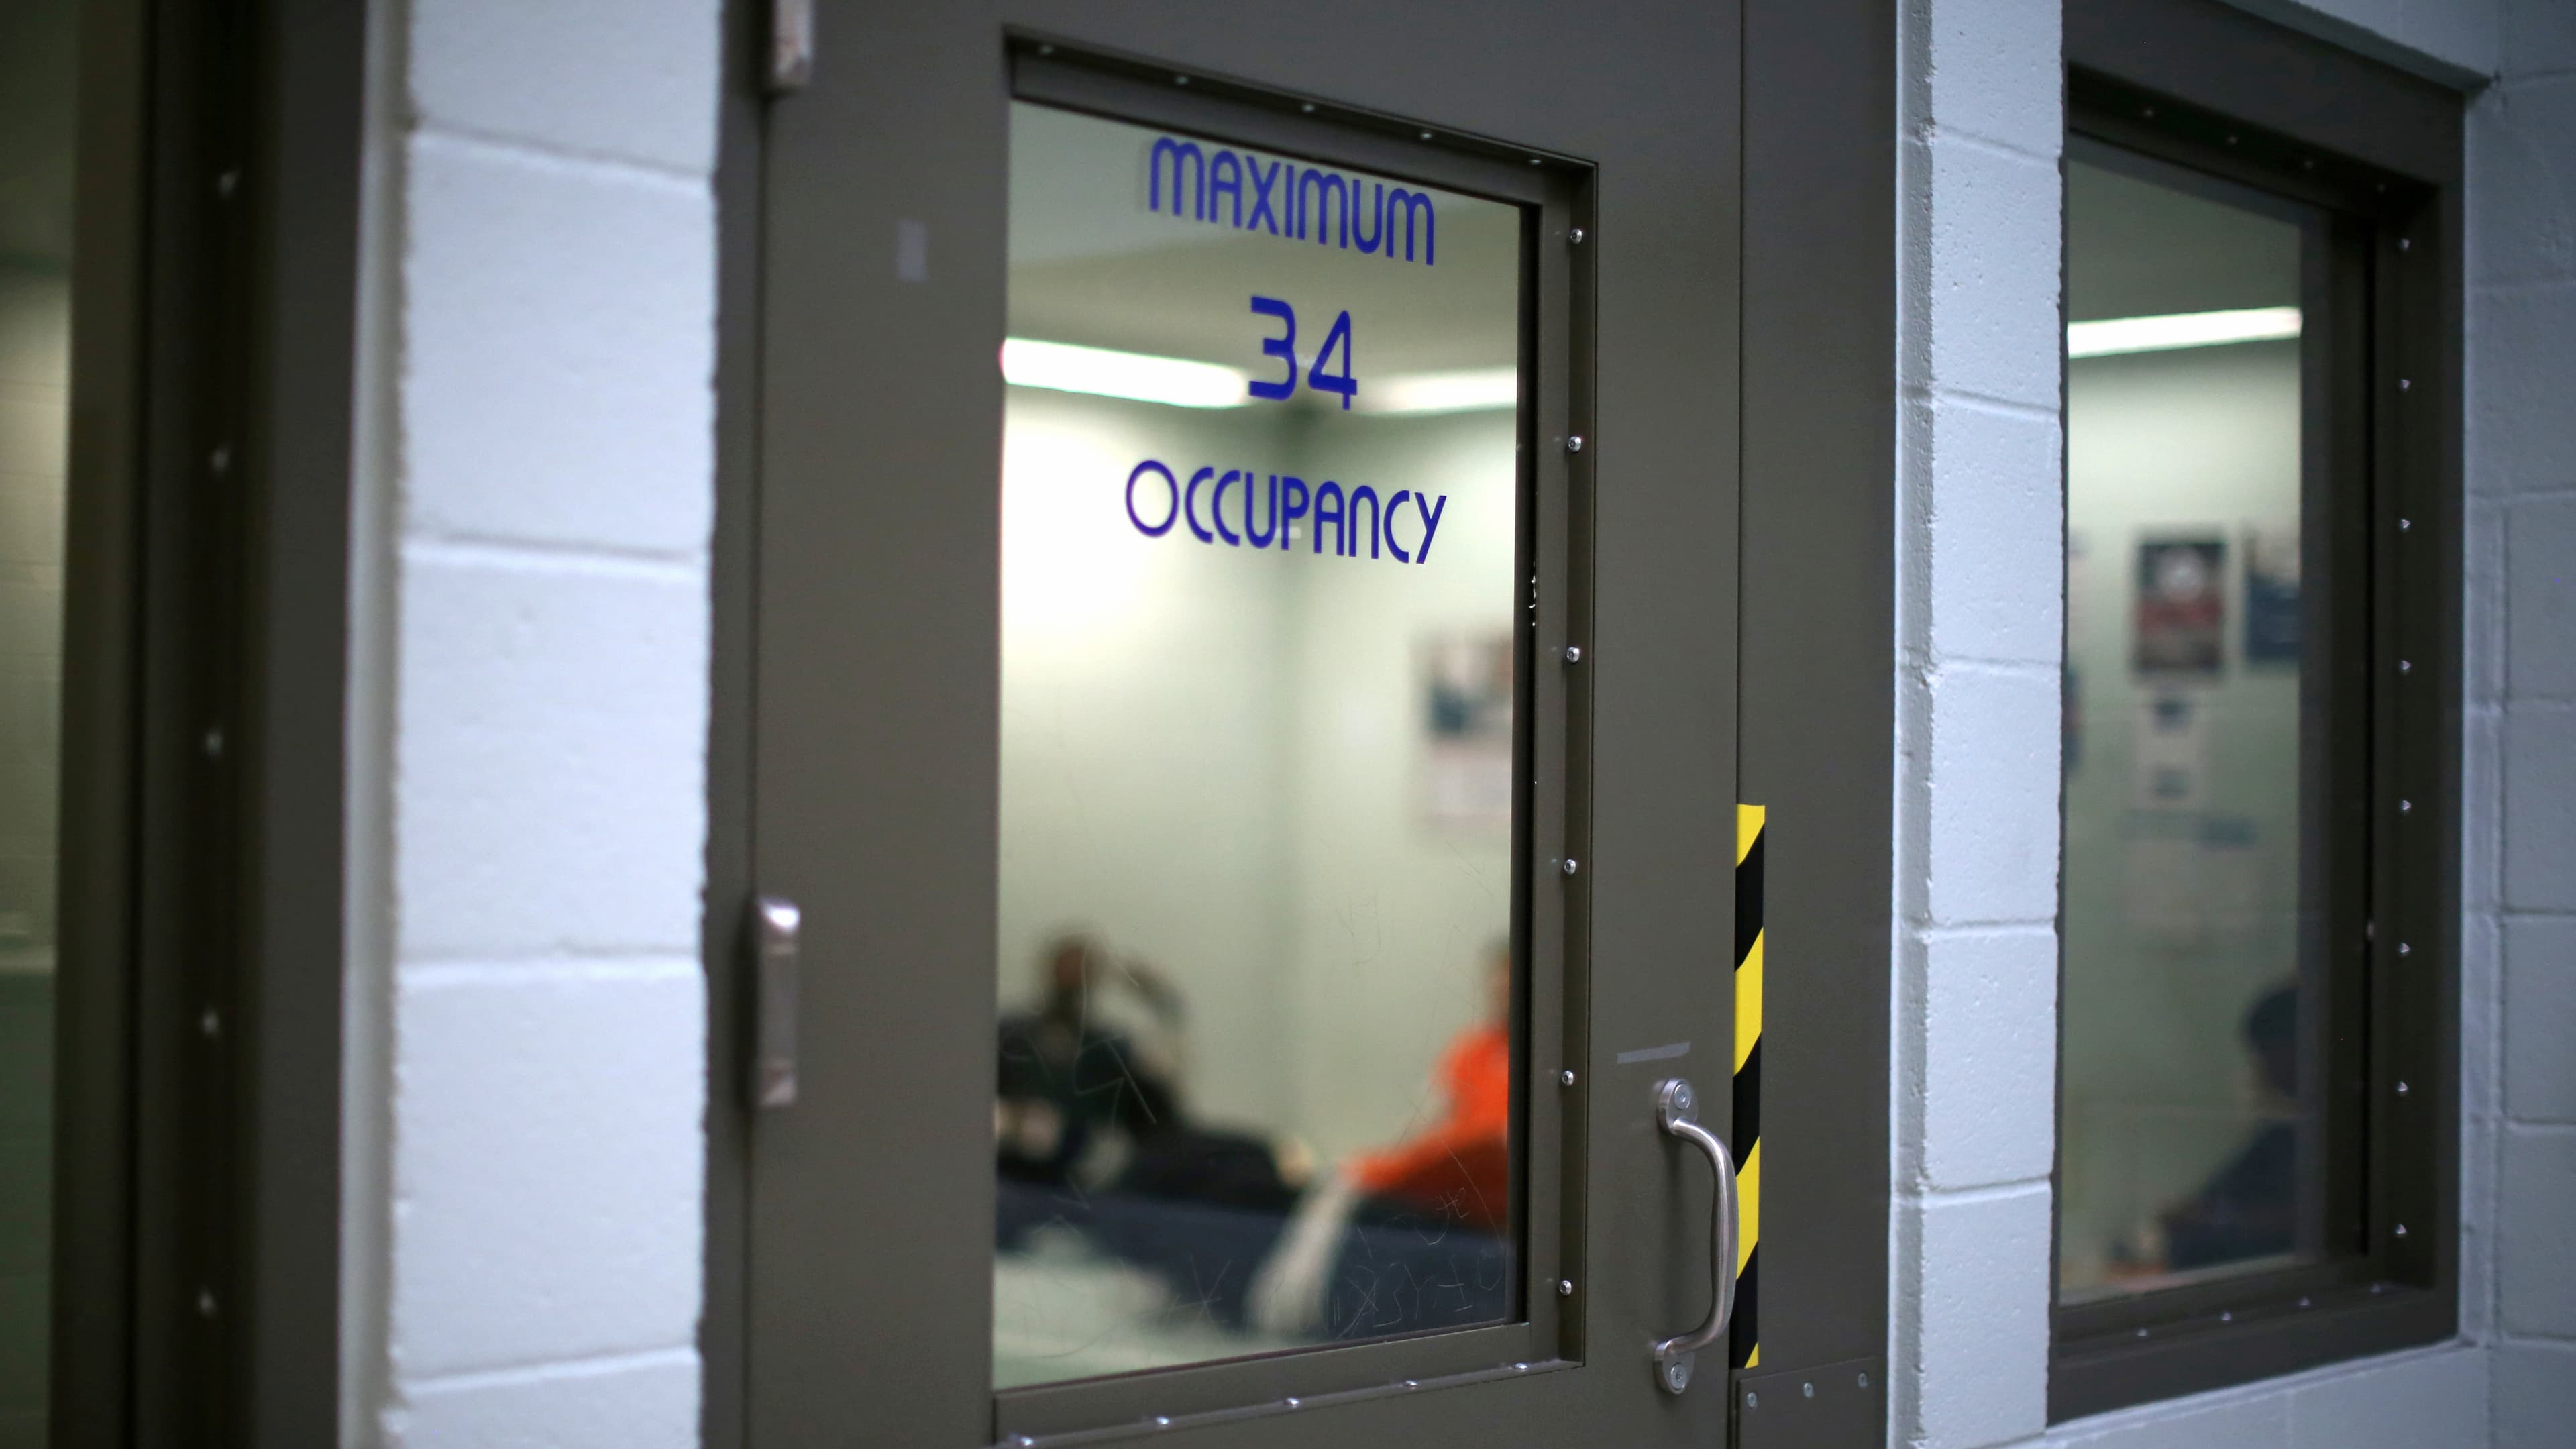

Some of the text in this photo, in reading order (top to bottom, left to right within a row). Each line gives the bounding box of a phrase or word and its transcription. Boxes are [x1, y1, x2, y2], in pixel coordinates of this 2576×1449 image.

[1149, 137, 1434, 266] MAXIMUM
[1248, 295, 1358, 411] 34
[1125, 459, 1447, 564] OCCUPANCY
